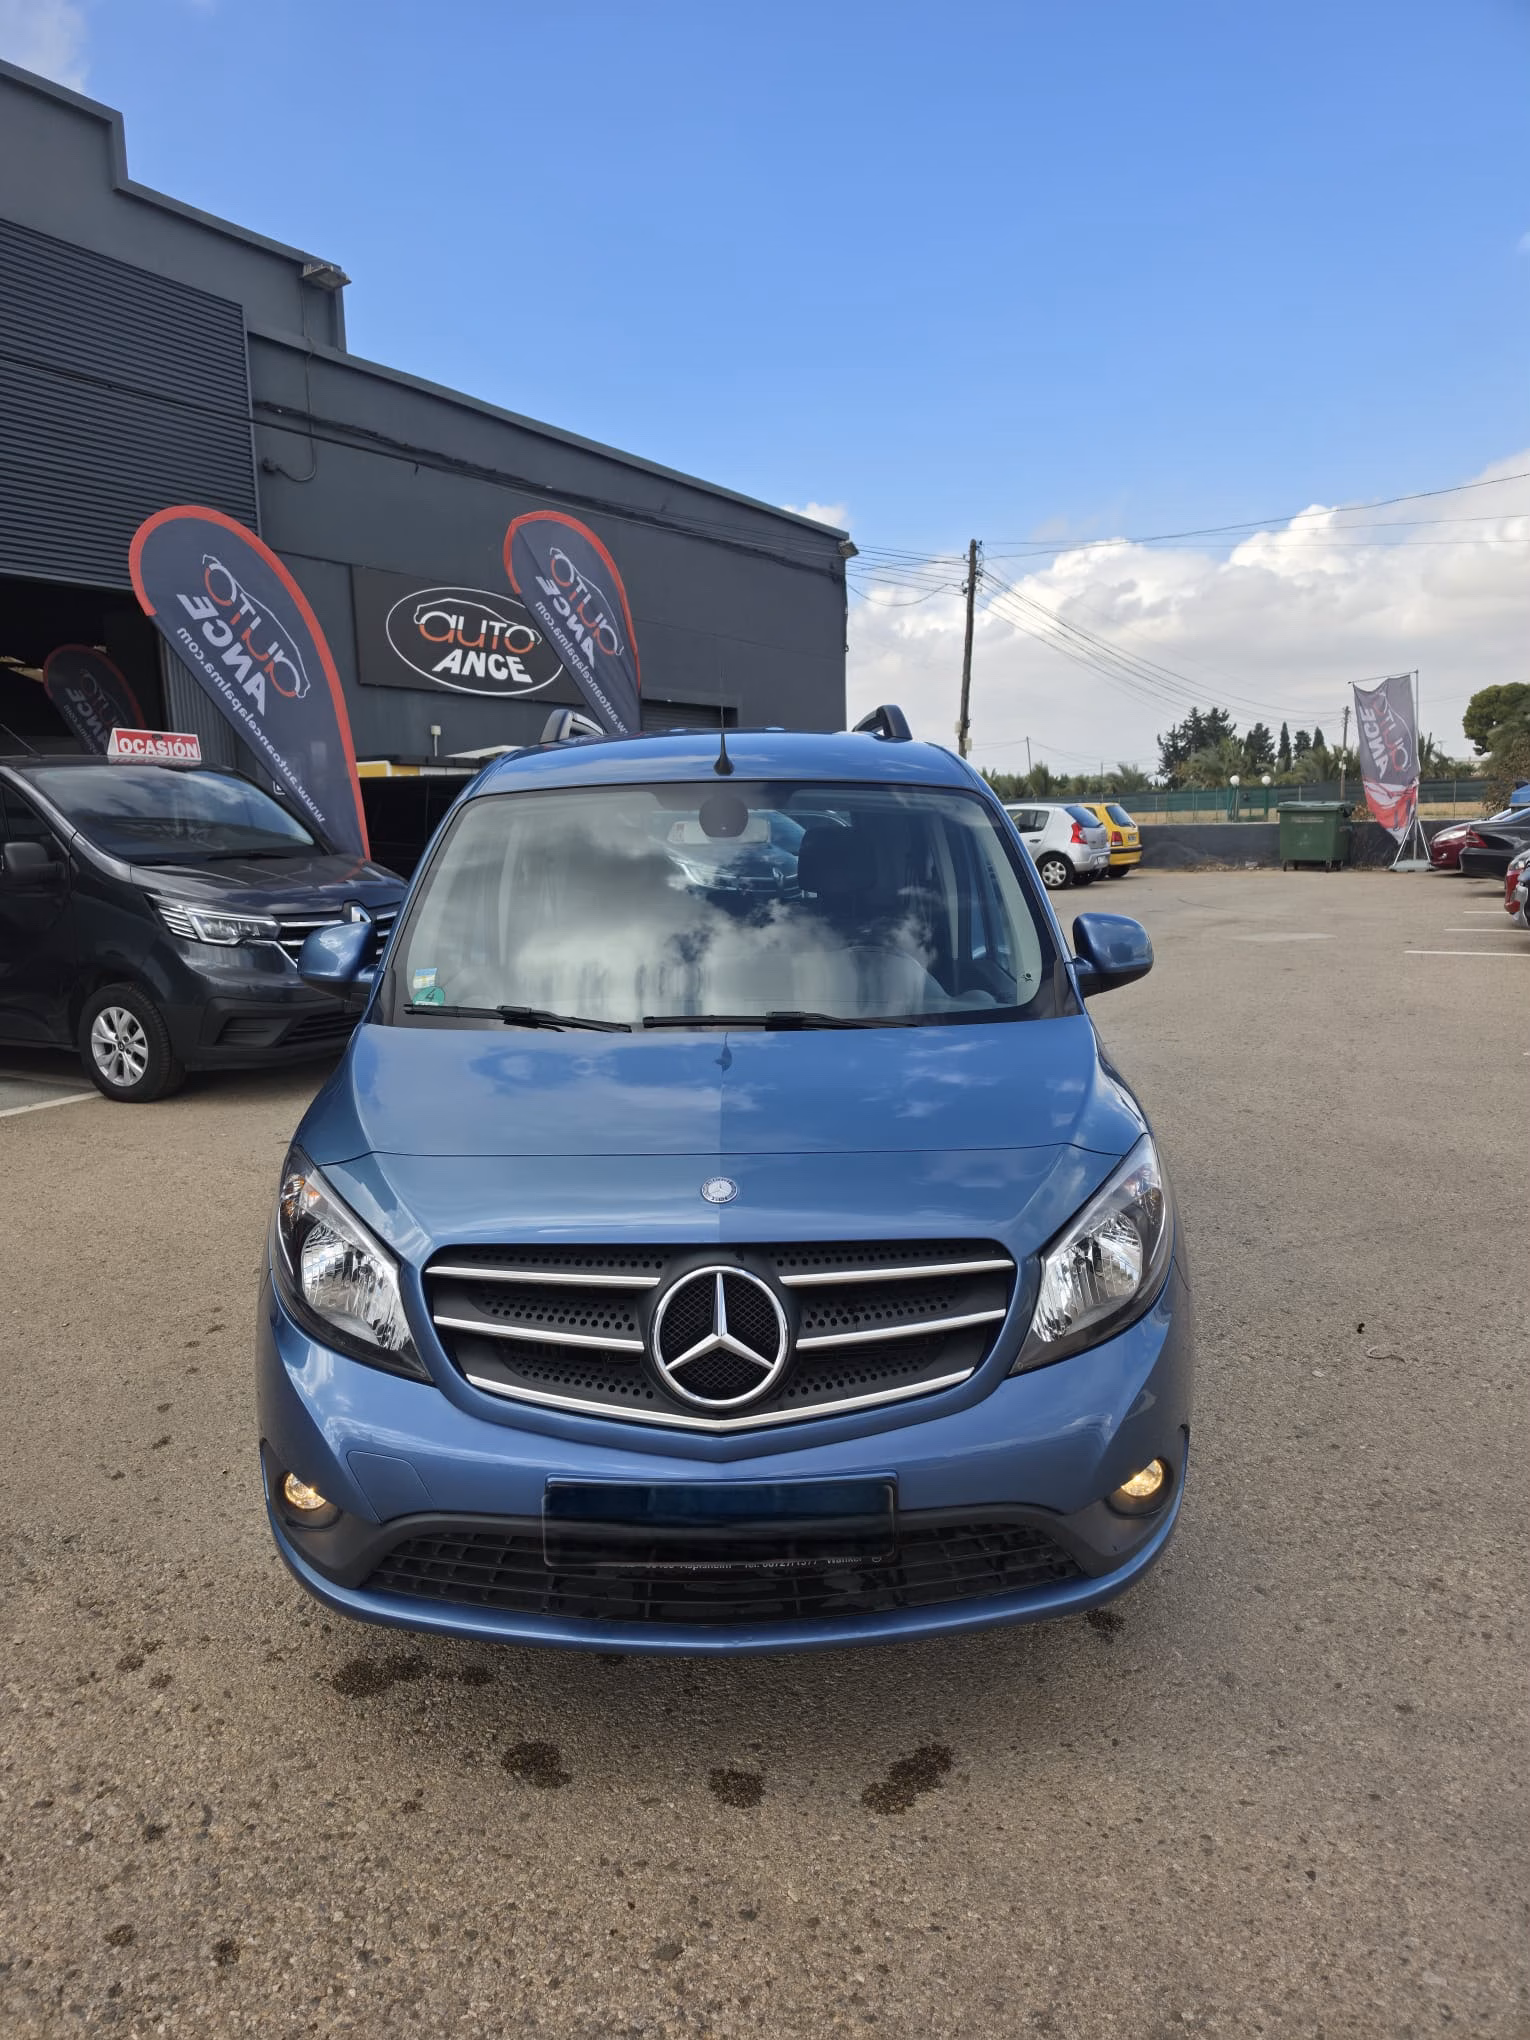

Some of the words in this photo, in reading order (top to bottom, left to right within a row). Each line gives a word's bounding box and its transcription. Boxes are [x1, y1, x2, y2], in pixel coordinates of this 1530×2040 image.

[432, 648, 533, 684] ANCE
[119, 737, 200, 759] OCASIÓN
[425, 988, 435, 1002] 4
